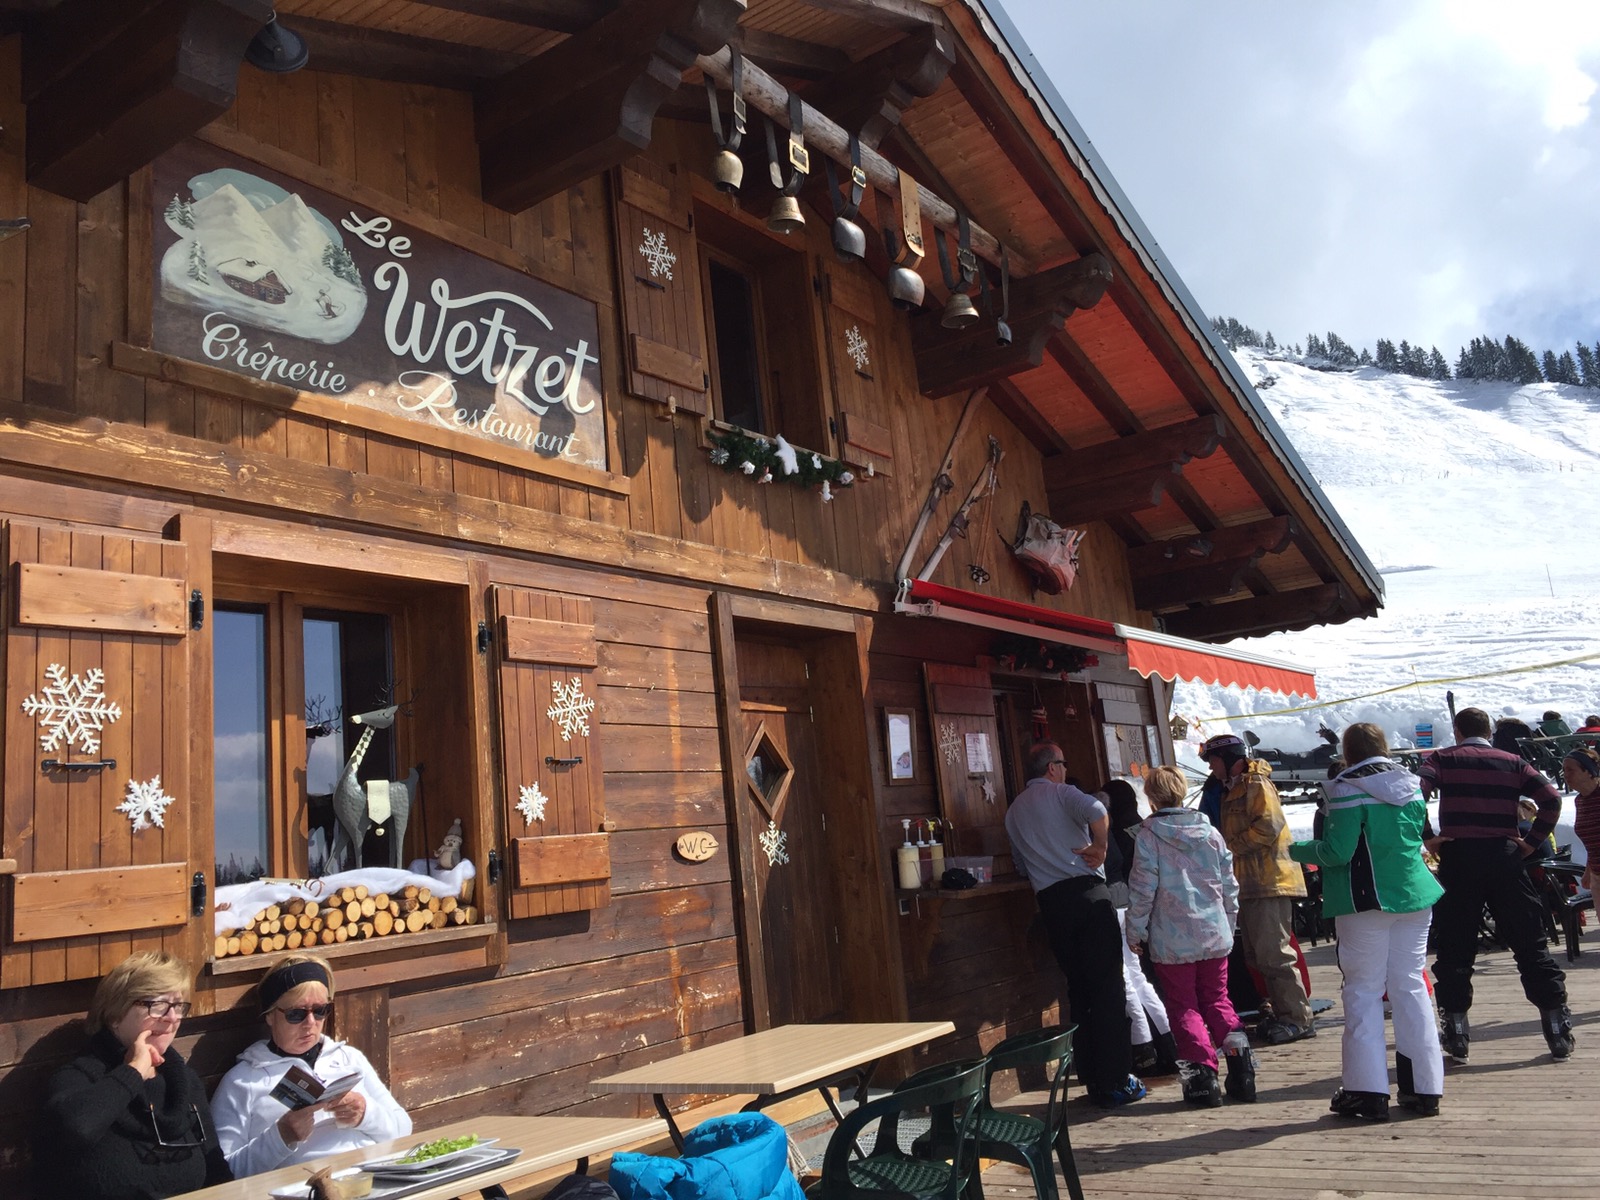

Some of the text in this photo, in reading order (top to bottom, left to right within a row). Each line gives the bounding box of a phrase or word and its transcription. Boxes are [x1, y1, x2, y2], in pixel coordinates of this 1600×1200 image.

[341, 211, 412, 258] Le
[202, 311, 580, 456] Crêperie Restaurant
[374, 262, 598, 415] Wetzet
[683, 837, 707, 854] WC
